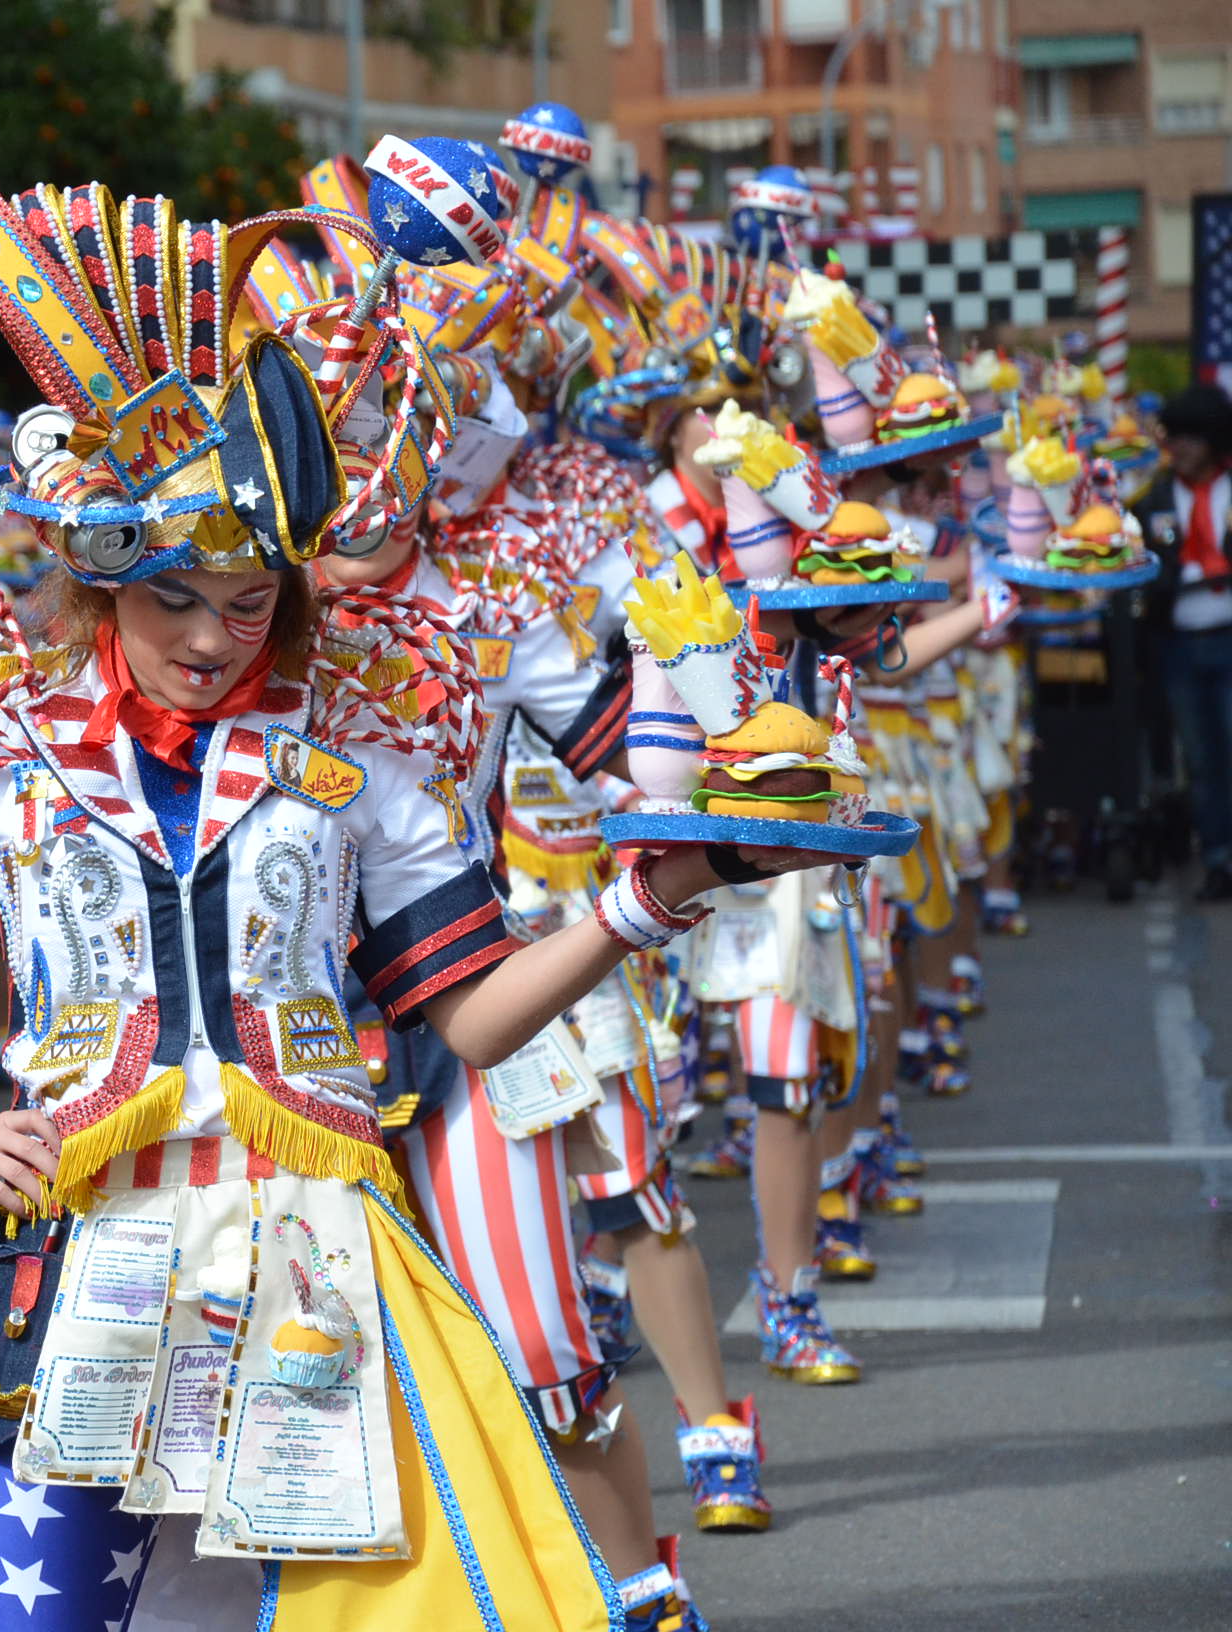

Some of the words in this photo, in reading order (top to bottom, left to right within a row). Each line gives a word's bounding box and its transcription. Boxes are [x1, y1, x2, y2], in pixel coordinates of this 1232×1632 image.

[303, 762, 355, 795] Waiter
[99, 1222, 169, 1247] Beverages
[63, 1364, 102, 1385] Side
